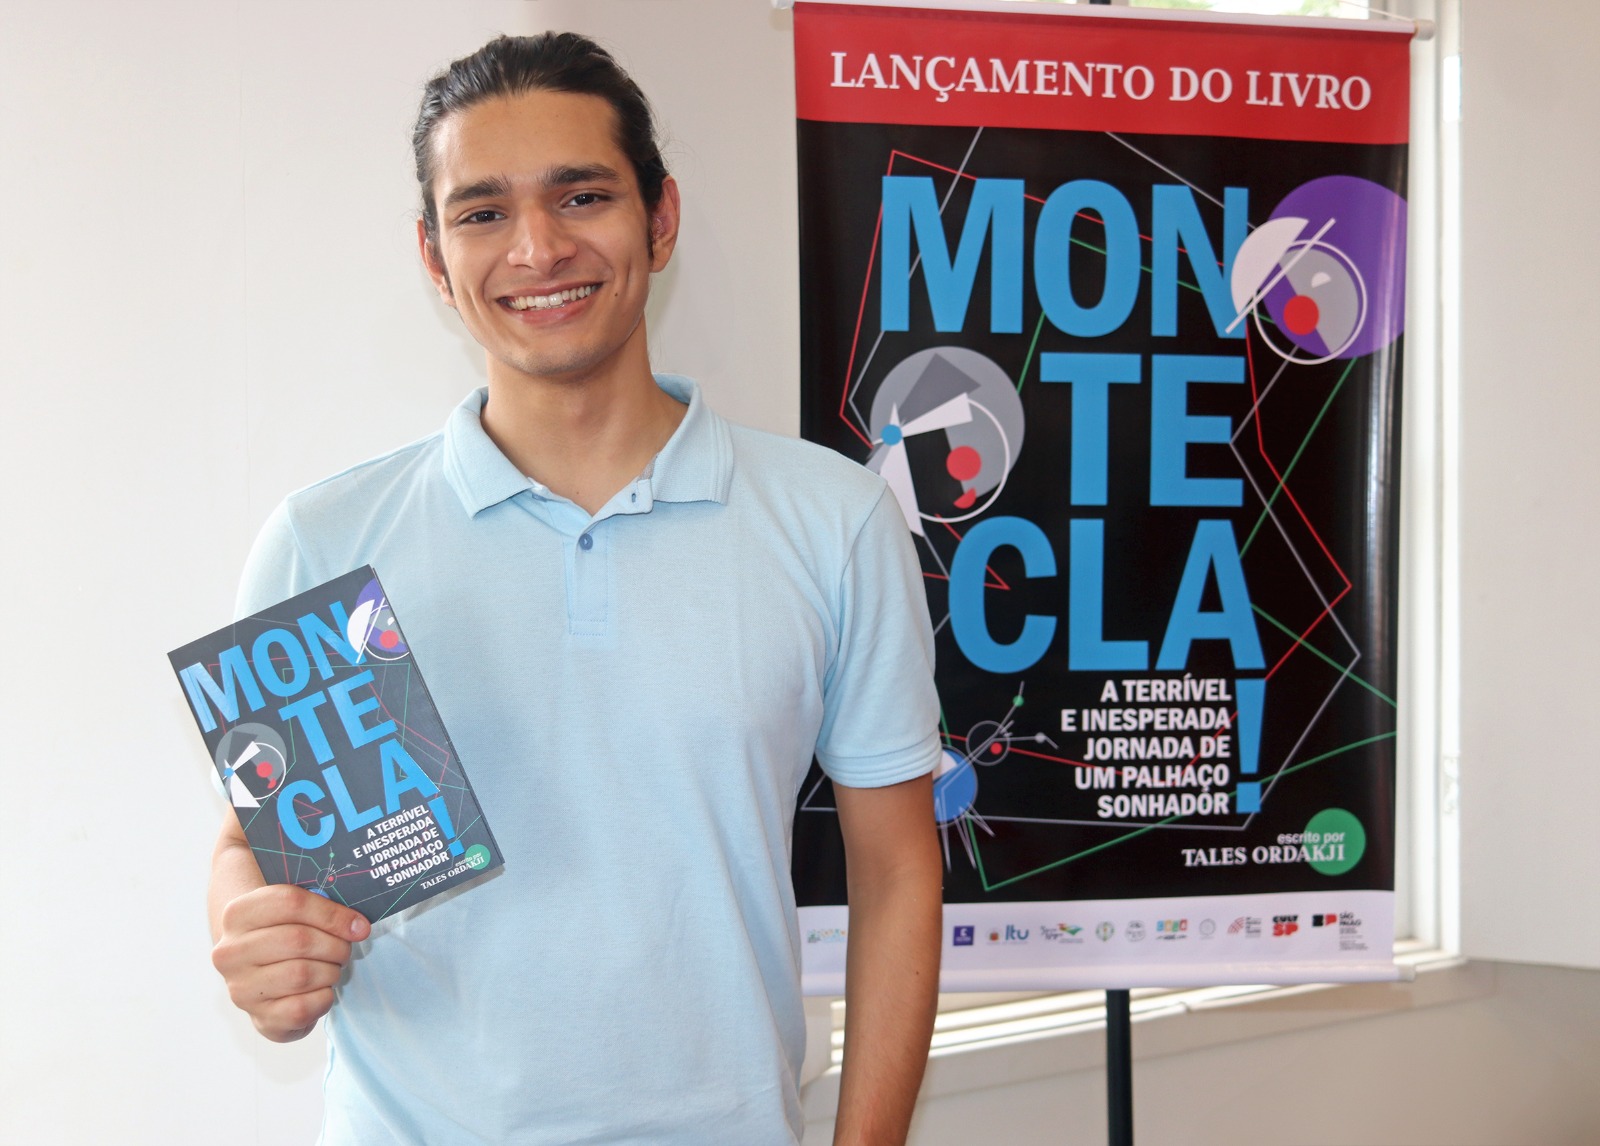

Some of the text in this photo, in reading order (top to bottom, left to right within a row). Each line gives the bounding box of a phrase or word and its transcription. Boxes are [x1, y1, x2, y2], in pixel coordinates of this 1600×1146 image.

[830, 51, 1372, 111] LANÇAMENTO DO LIVRO
[881, 175, 1249, 339] MON
[1040, 352, 1245, 507] TE
[179, 601, 367, 733] MON
[1100, 673, 1231, 703] A TERRÍVEL
[278, 669, 398, 765] TE
[1061, 707, 1231, 731] E INESPERADA
[1083, 736, 1231, 760] JORNADA DE
[1075, 764, 1229, 792] UM PALHAÇO
[367, 805, 429, 839] A TERRÍVEL
[1097, 794, 1229, 818] SONHADOR
[353, 816, 434, 859] E INESPERADA
[369, 827, 440, 866] JORNADA DE
[1277, 832, 1346, 848] escrito por
[370, 840, 444, 879] UM PALHAÇO
[385, 851, 449, 887] SONHADOR
[1181, 844, 1346, 867] TALES ORDAKJI
[420, 856, 485, 889] TALES ORDAKJI
[1272, 915, 1299, 923] CULT
[1272, 923, 1299, 937] SP
